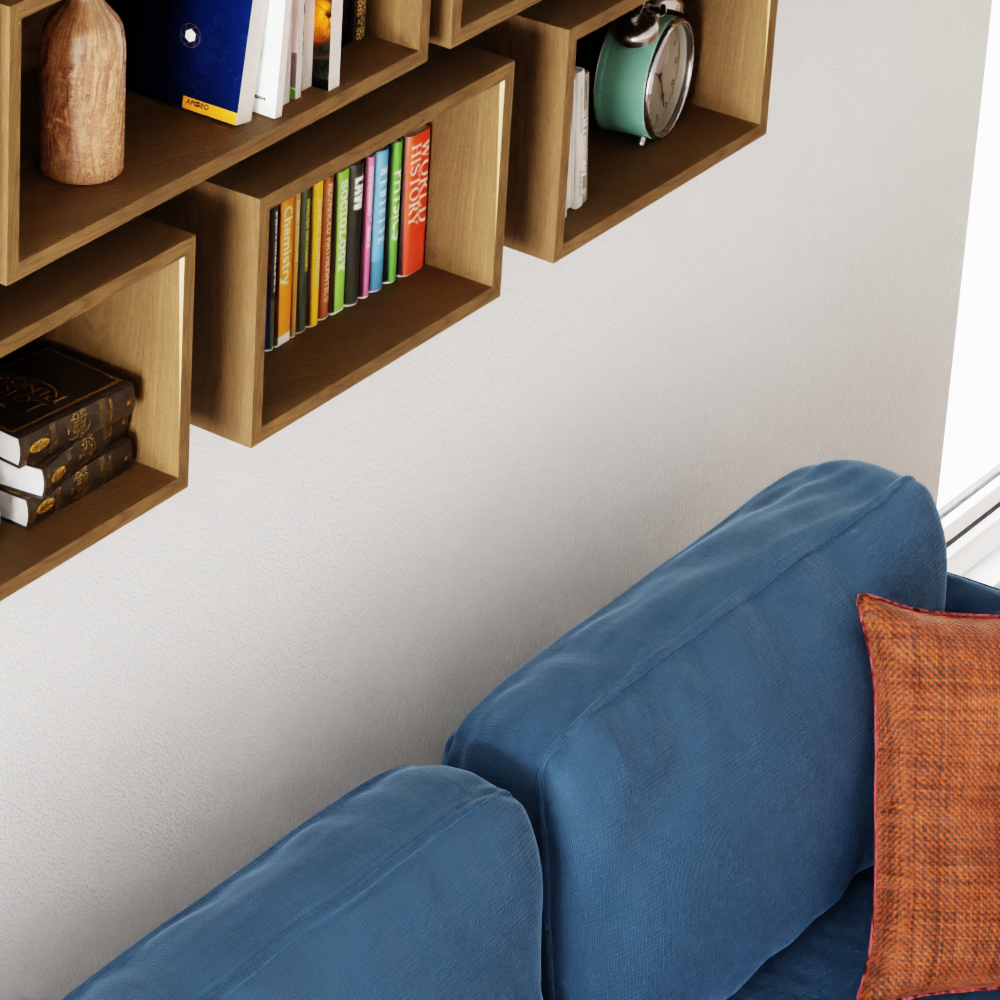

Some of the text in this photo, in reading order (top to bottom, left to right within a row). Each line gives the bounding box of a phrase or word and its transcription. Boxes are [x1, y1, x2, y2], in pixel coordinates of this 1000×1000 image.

[353, 175, 364, 211] LAW
[391, 169, 402, 241] PHYSICS
[408, 142, 422, 225] HISTORY
[418, 138, 430, 223] WORLD
[280, 205, 293, 286] Chemistry
[338, 180, 349, 272] SOCIOLOGY
